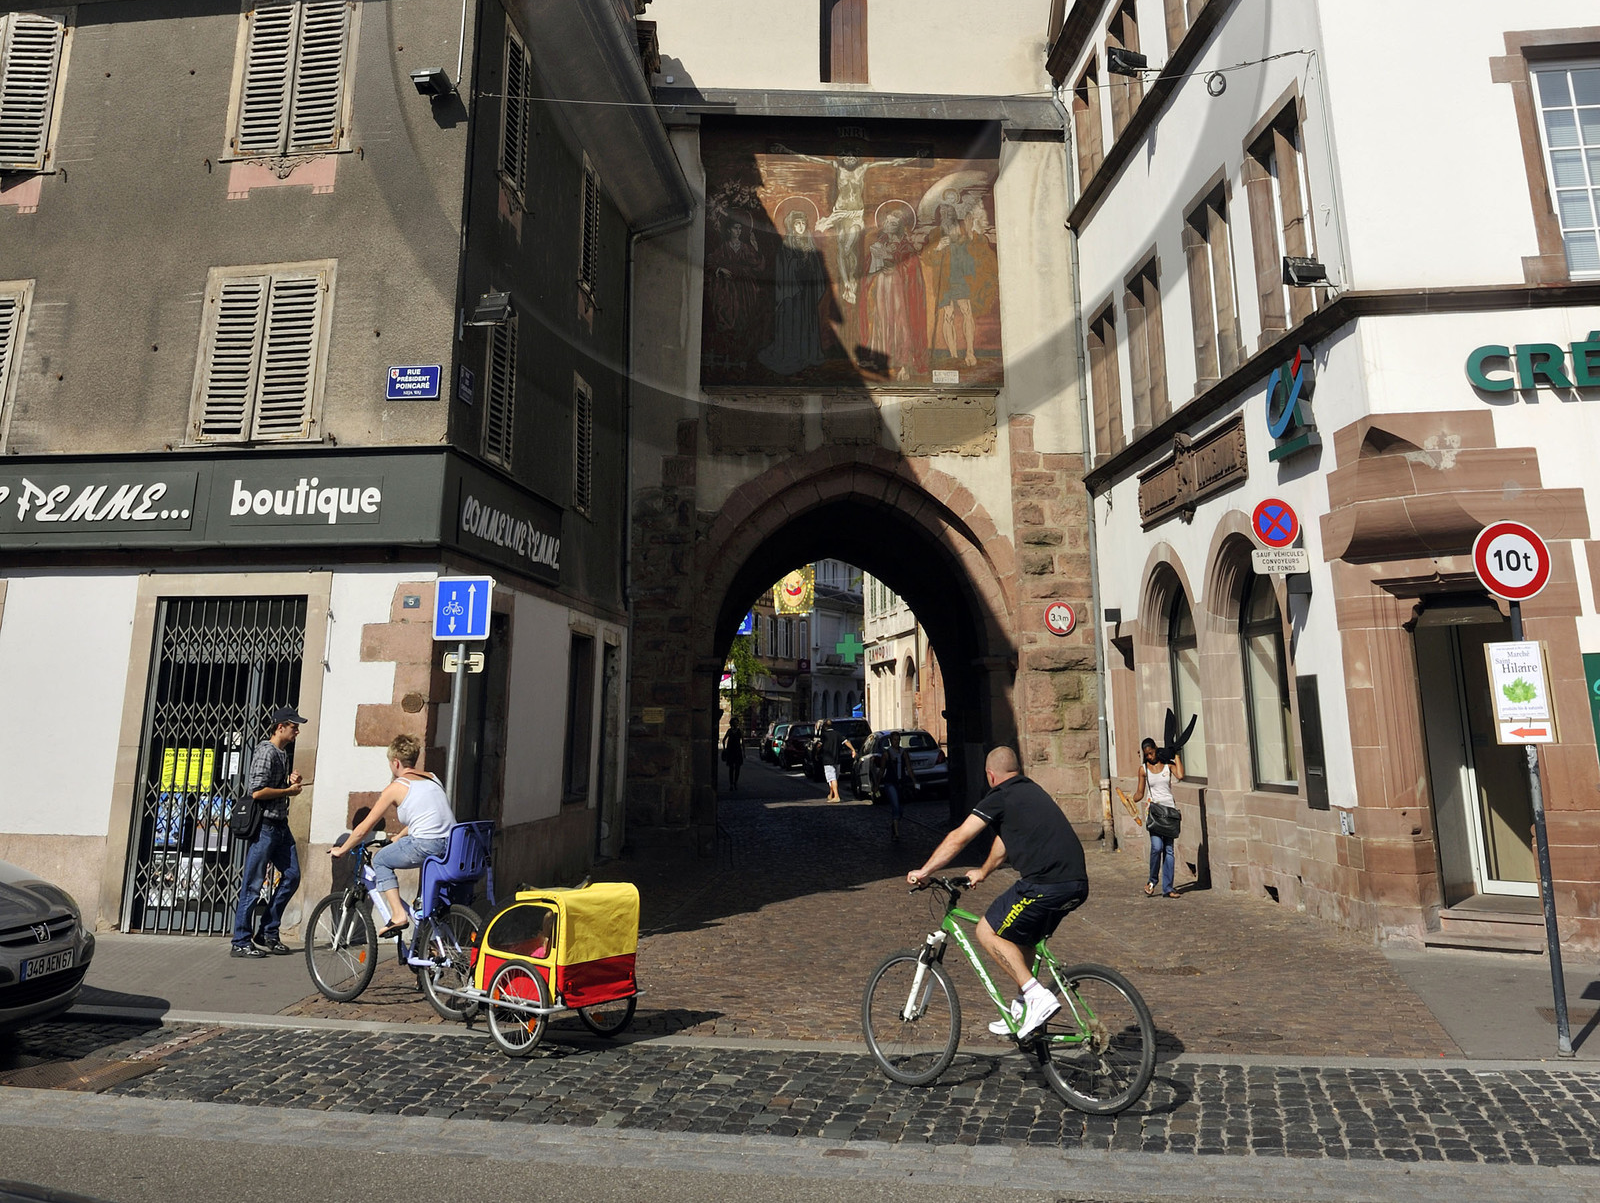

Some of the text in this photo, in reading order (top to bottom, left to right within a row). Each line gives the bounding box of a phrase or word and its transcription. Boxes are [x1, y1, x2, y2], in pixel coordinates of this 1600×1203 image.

[396, 375, 430, 383] PRÉSIDENT
[395, 382, 430, 390] POINCARÉ
[230, 477, 382, 524] boutique
[462, 495, 505, 546] COMME
[505, 513, 527, 556] UNE
[1273, 550, 1304, 558] VÉHICULES
[408, 598, 415, 606] 5
[1502, 662, 1538, 673] Hilaire
[27, 951, 72, 978] 348 AEN 67
